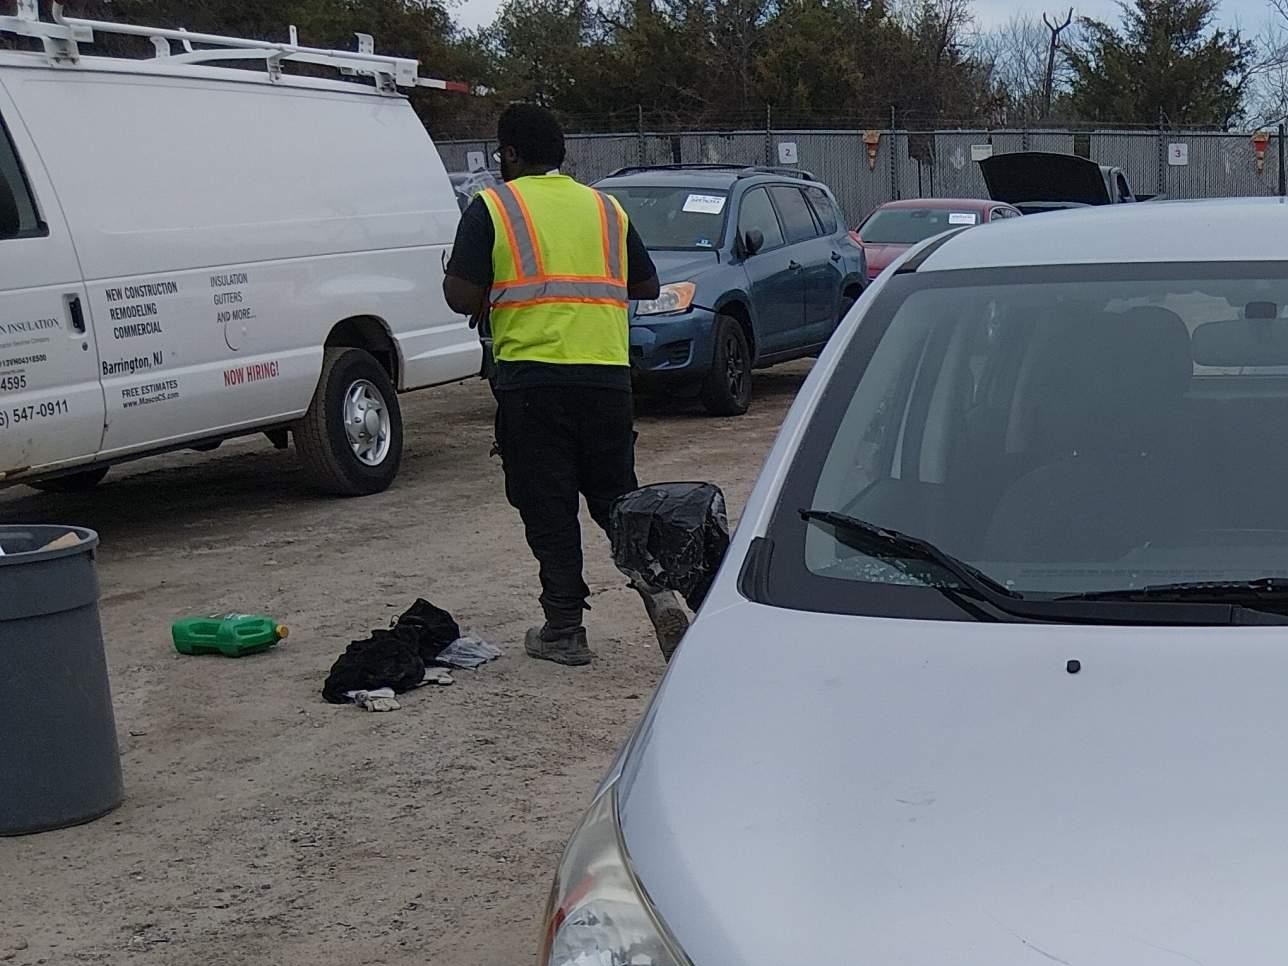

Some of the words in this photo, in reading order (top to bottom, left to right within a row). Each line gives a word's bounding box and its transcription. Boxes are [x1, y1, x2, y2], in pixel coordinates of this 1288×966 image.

[210, 273, 248, 287] INSULATION
[105, 288, 123, 301] NEW
[124, 281, 178, 299] CONSTRUCTION
[213, 291, 243, 305] GUTTERS
[109, 303, 158, 320] REMODELING
[216, 312, 231, 323] AND
[113, 321, 162, 339] COMMERCIAL
[102, 357, 152, 376] Barrington,
[153, 351, 164, 365] NJ
[223, 369, 245, 387] NOW
[246, 361, 280, 382] HIRING!
[122, 388, 141, 399] FREE
[141, 380, 178, 395] ESTIMATES
[13, 399, 69, 423] 547-0911
